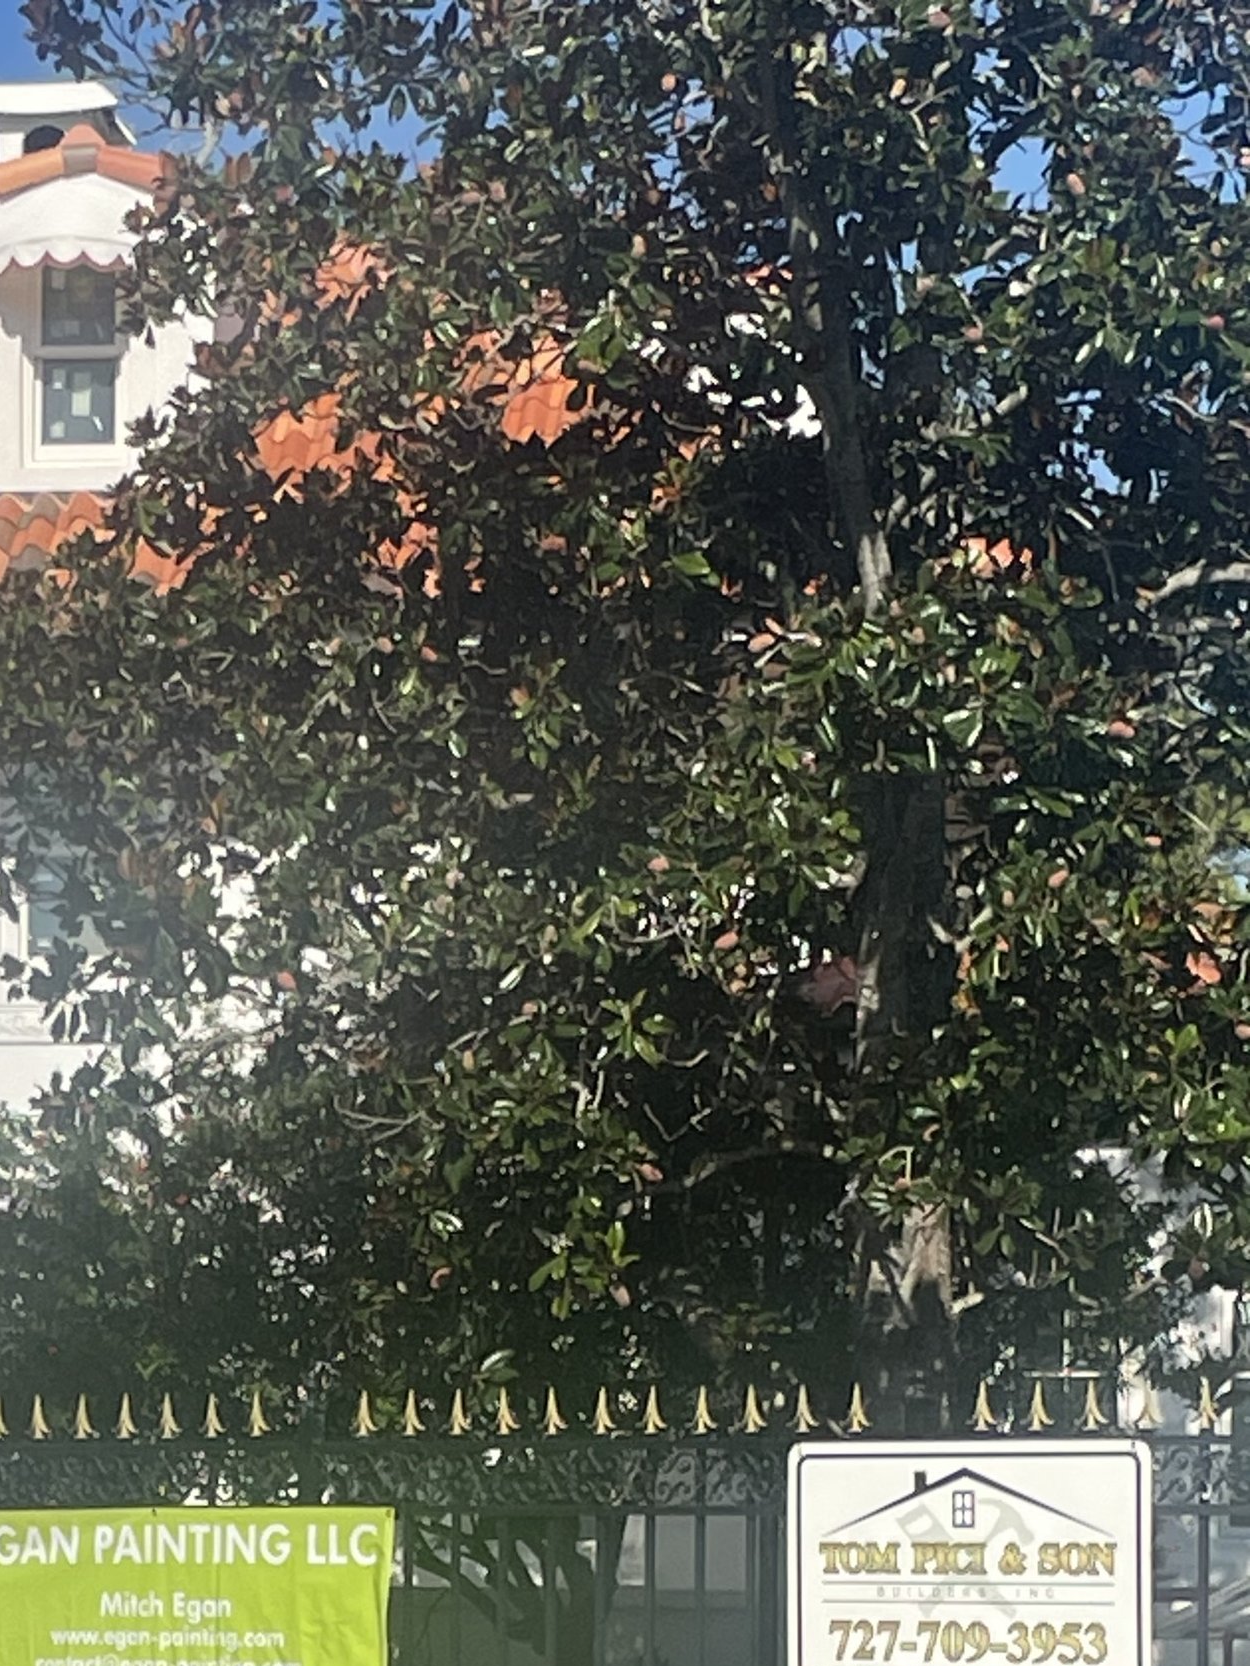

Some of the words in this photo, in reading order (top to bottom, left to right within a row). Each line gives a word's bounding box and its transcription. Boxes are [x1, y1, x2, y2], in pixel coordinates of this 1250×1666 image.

[94, 1524, 292, 1566] PAINTING
[307, 1524, 379, 1566] LLC
[819, 1541, 901, 1575] TOM
[911, 1541, 988, 1576] PICI
[998, 1542, 1028, 1576] &
[1038, 1542, 1117, 1577] SON
[100, 1592, 163, 1618] Mitch
[173, 1592, 231, 1624] Egan
[50, 1626, 285, 1653] www.egan-painting.com
[829, 1619, 1108, 1666] 727-709-3953
